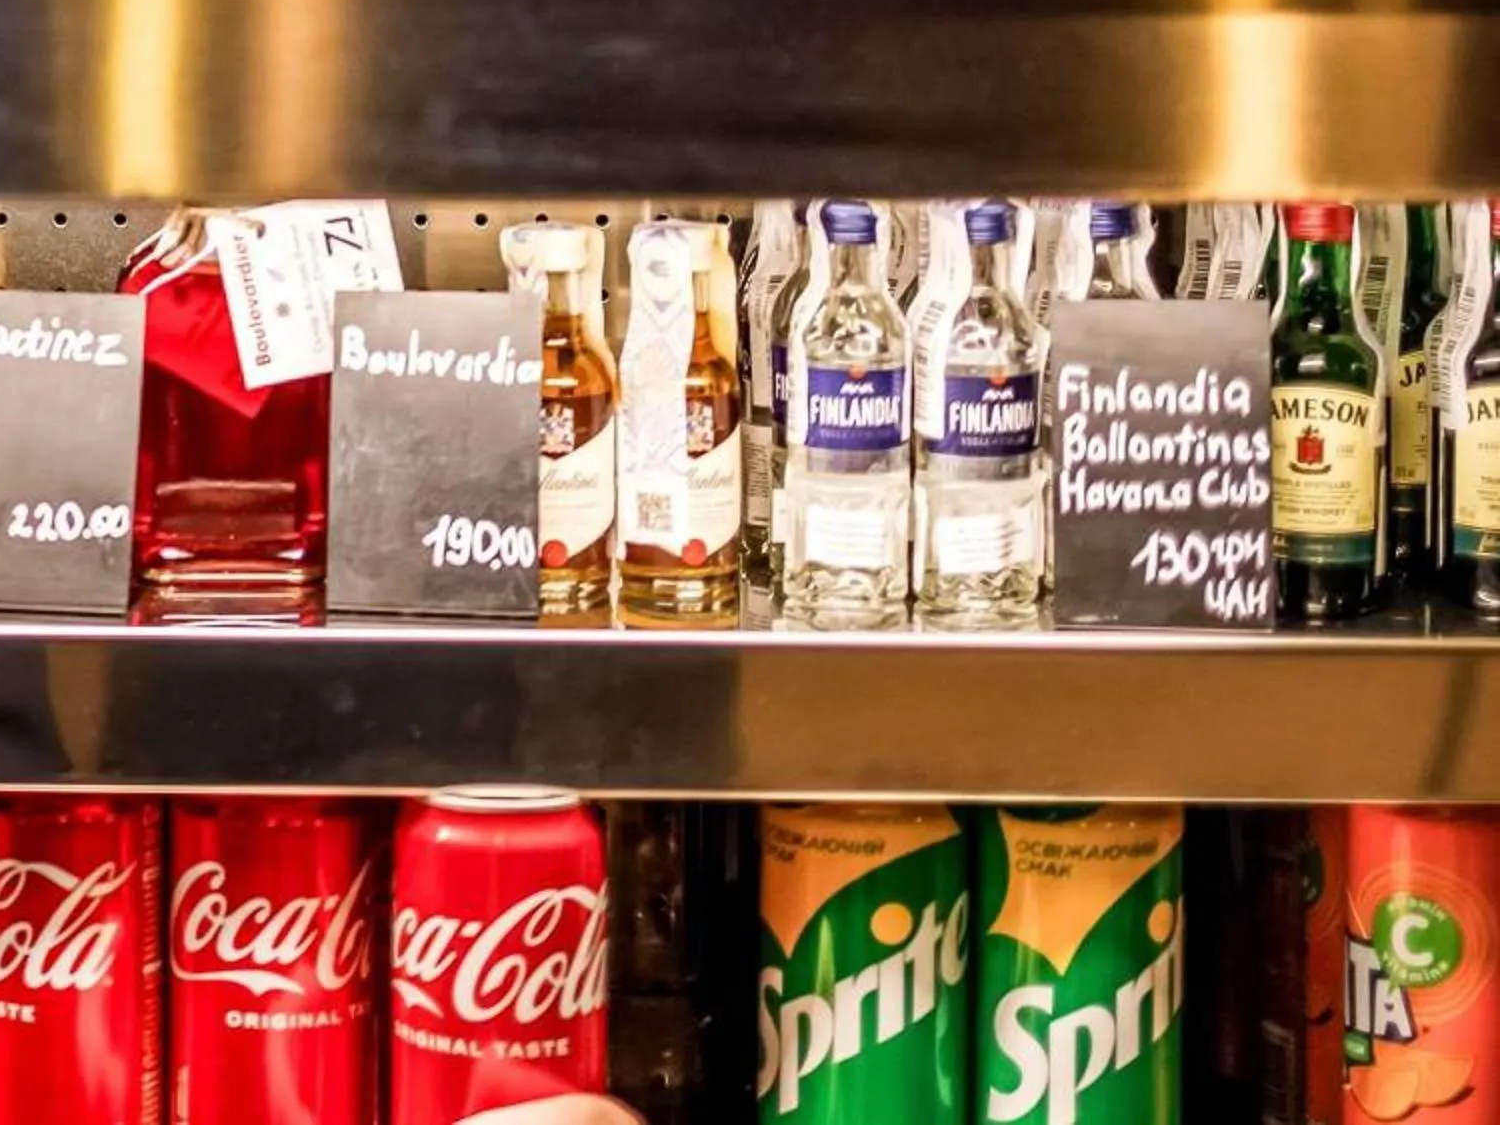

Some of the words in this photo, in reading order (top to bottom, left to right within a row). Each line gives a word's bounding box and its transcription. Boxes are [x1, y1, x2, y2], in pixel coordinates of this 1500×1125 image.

[233, 234, 272, 367] Boulevardier
[810, 395, 899, 429] FINLANDIA
[1057, 364, 1253, 417] Finlandia
[1271, 397, 1370, 427] AMESON
[950, 400, 1035, 434] FINLANDIA
[1058, 470, 1193, 516] Havana
[1196, 468, 1270, 512] Club
[1390, 913, 1434, 966] C
[757, 890, 968, 1115] Sprite
[1344, 935, 1414, 1039] TA
[225, 1008, 343, 1031] ORIGINAL
[393, 1020, 484, 1059] RIGINAL
[494, 1038, 571, 1058] TASTE
